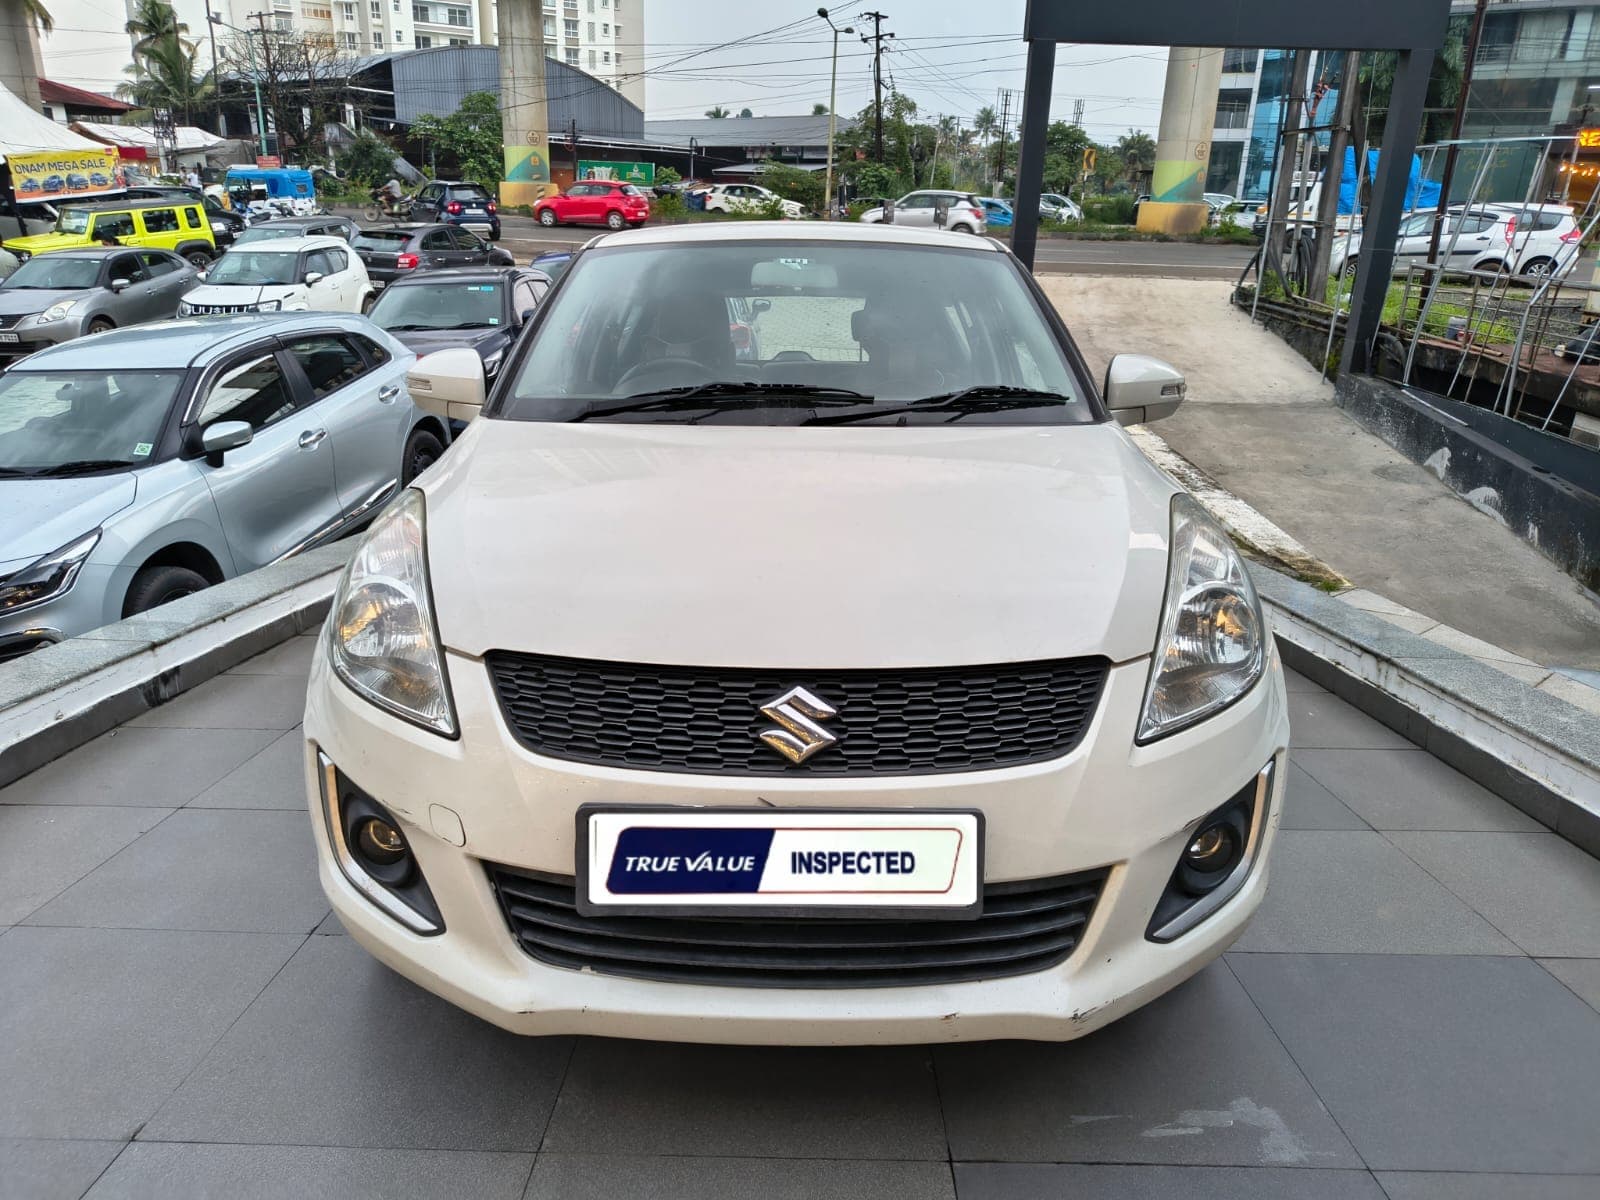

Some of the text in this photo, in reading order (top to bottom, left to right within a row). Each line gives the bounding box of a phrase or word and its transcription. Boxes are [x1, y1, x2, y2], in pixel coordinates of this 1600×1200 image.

[14, 158, 106, 174] ONAM MEGA SALE
[624, 850, 915, 875] TRUE VALUE INSPECTED
